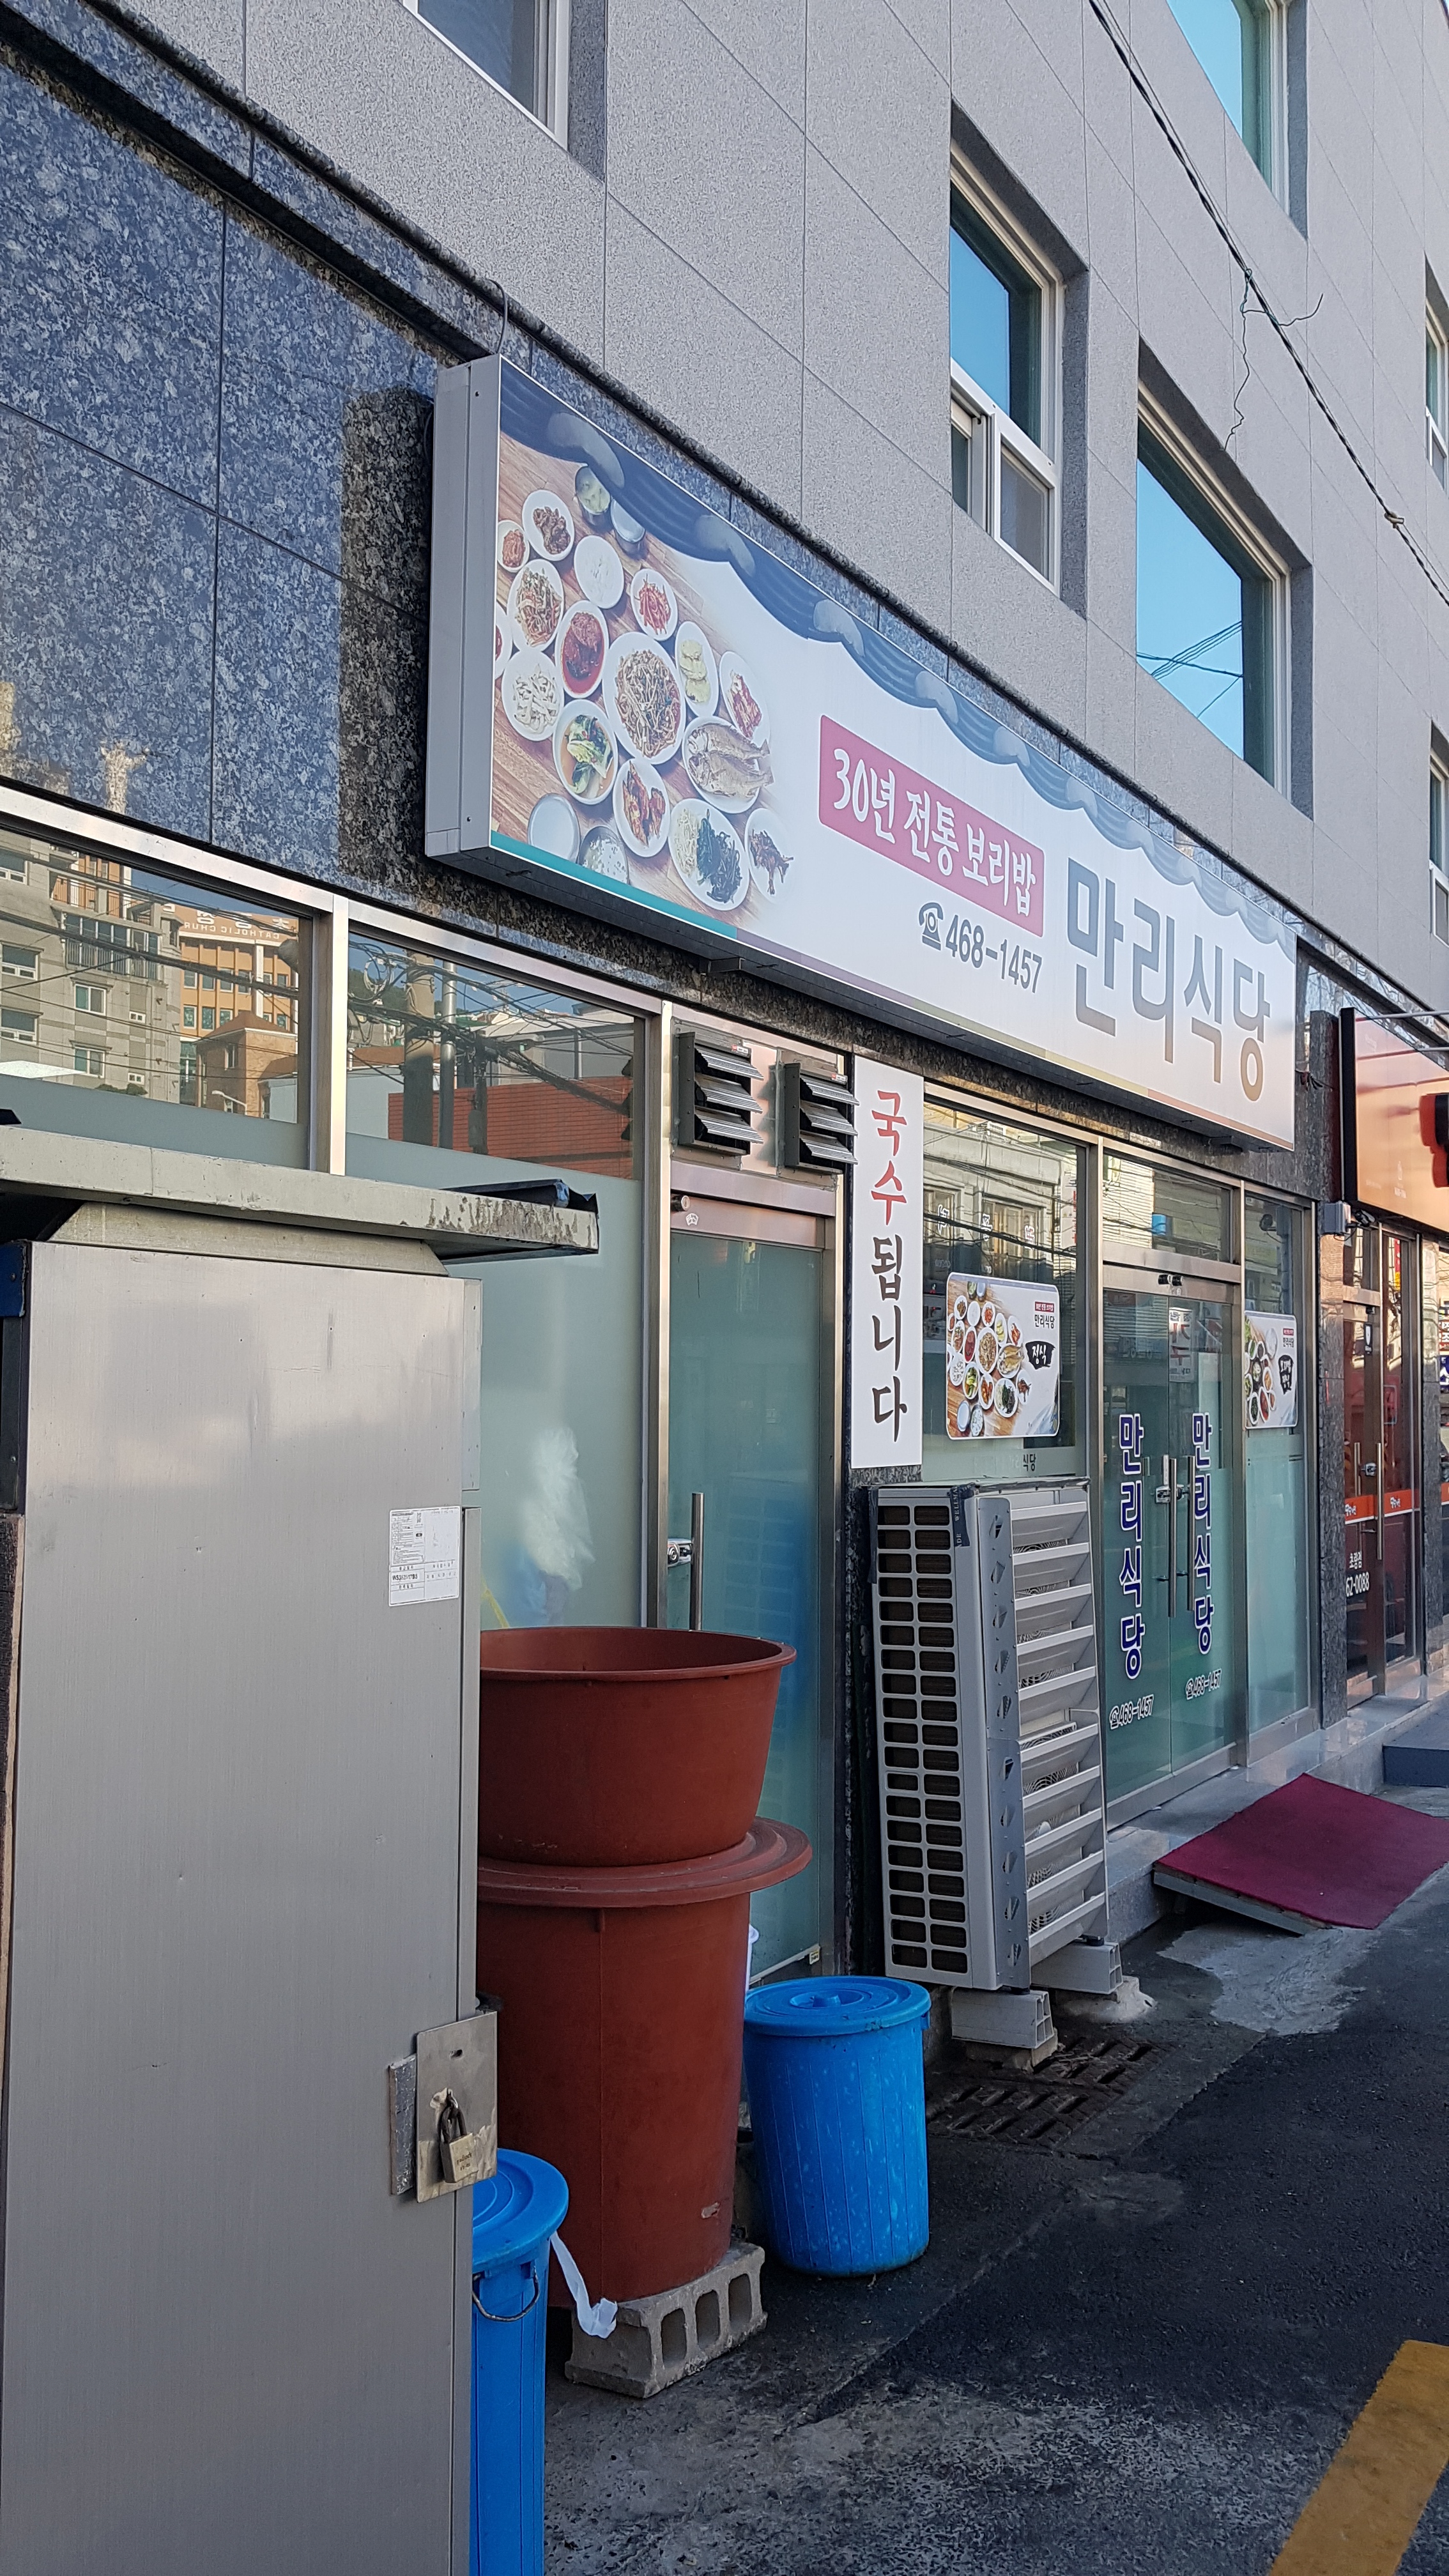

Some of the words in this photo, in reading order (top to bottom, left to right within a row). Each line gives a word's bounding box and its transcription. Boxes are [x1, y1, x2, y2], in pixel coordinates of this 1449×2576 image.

[833, 748, 896, 844] 30년
[903, 790, 958, 877] 전통
[963, 824, 1036, 917] 보리밥
[946, 914, 1043, 993] 468-1457
[1067, 858, 1271, 1101] 만리식당
[1032, 1344, 1046, 1365] 정식
[1034, 1314, 1055, 1329] 만리식당
[1119, 1413, 1145, 1679] 만리식당
[1192, 1413, 1213, 1654] 만리식당
[1119, 1694, 1154, 1726] 468-1457
